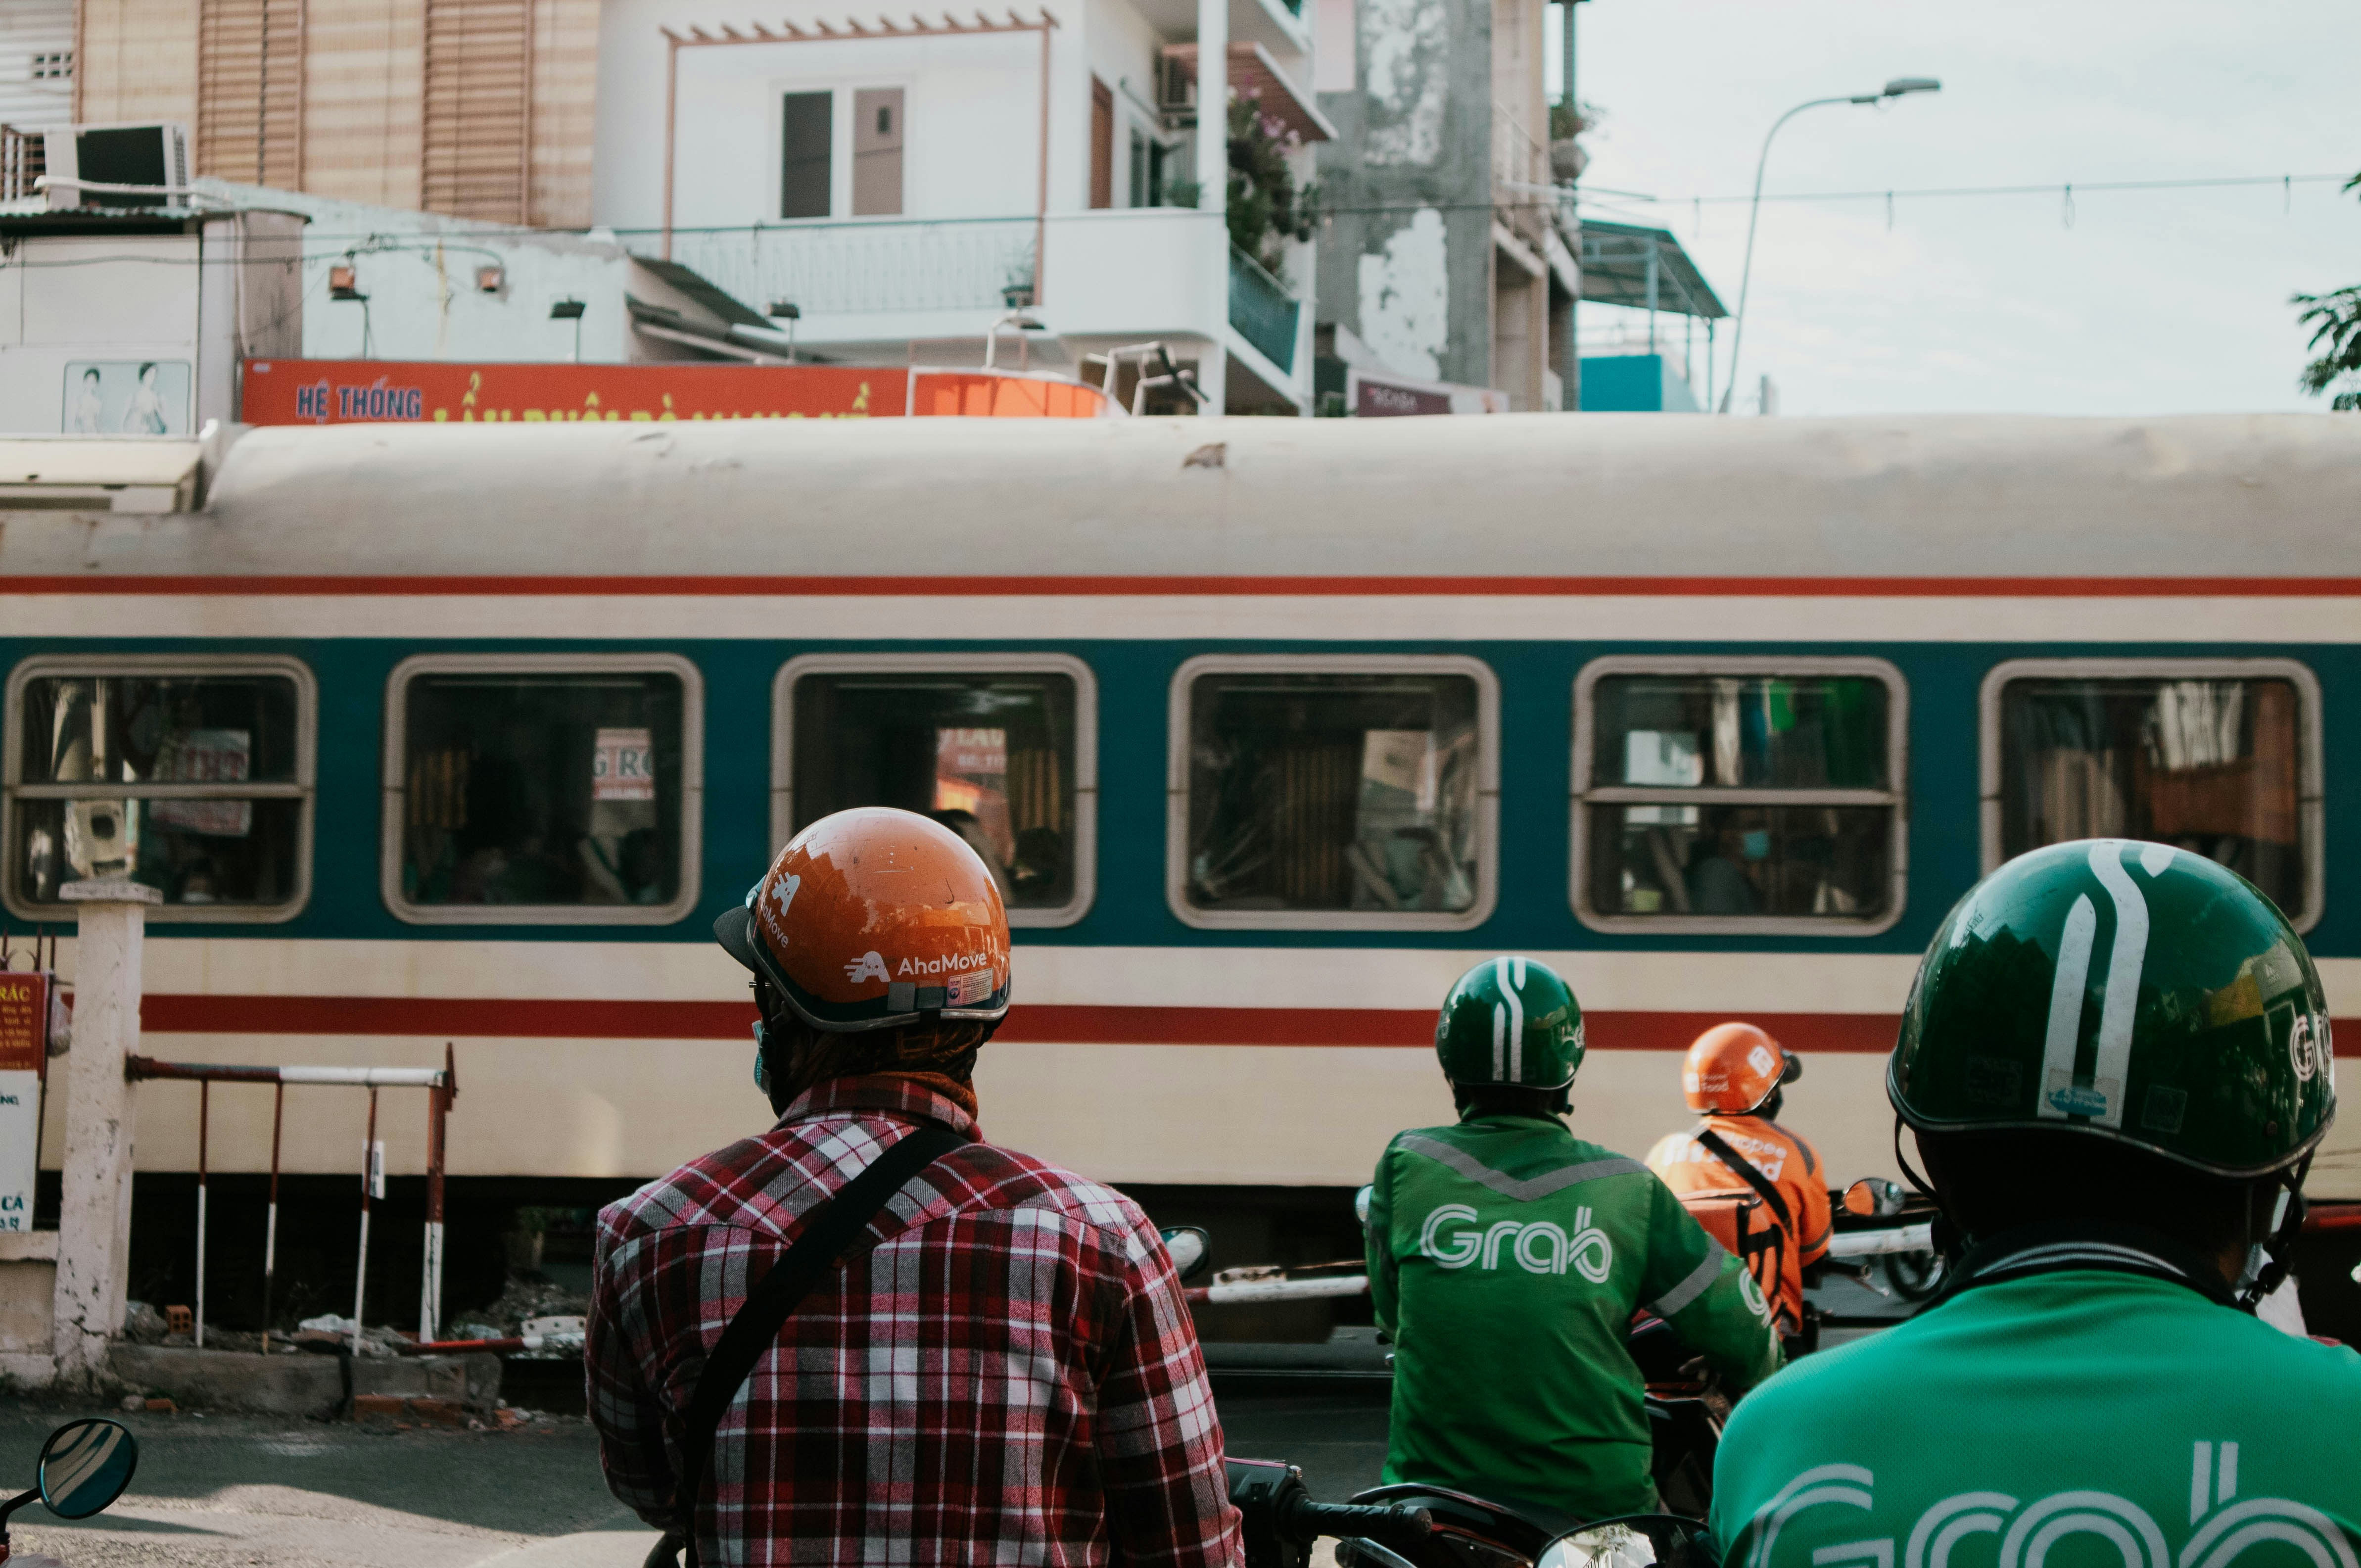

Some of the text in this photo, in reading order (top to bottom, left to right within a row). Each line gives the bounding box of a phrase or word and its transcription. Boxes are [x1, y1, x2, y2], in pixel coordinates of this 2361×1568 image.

[337, 375, 422, 419] THỐNG
[897, 952, 987, 976] AhaMove
[1419, 1203, 1613, 1283] Grab
[1748, 1441, 2360, 1568] Grab
